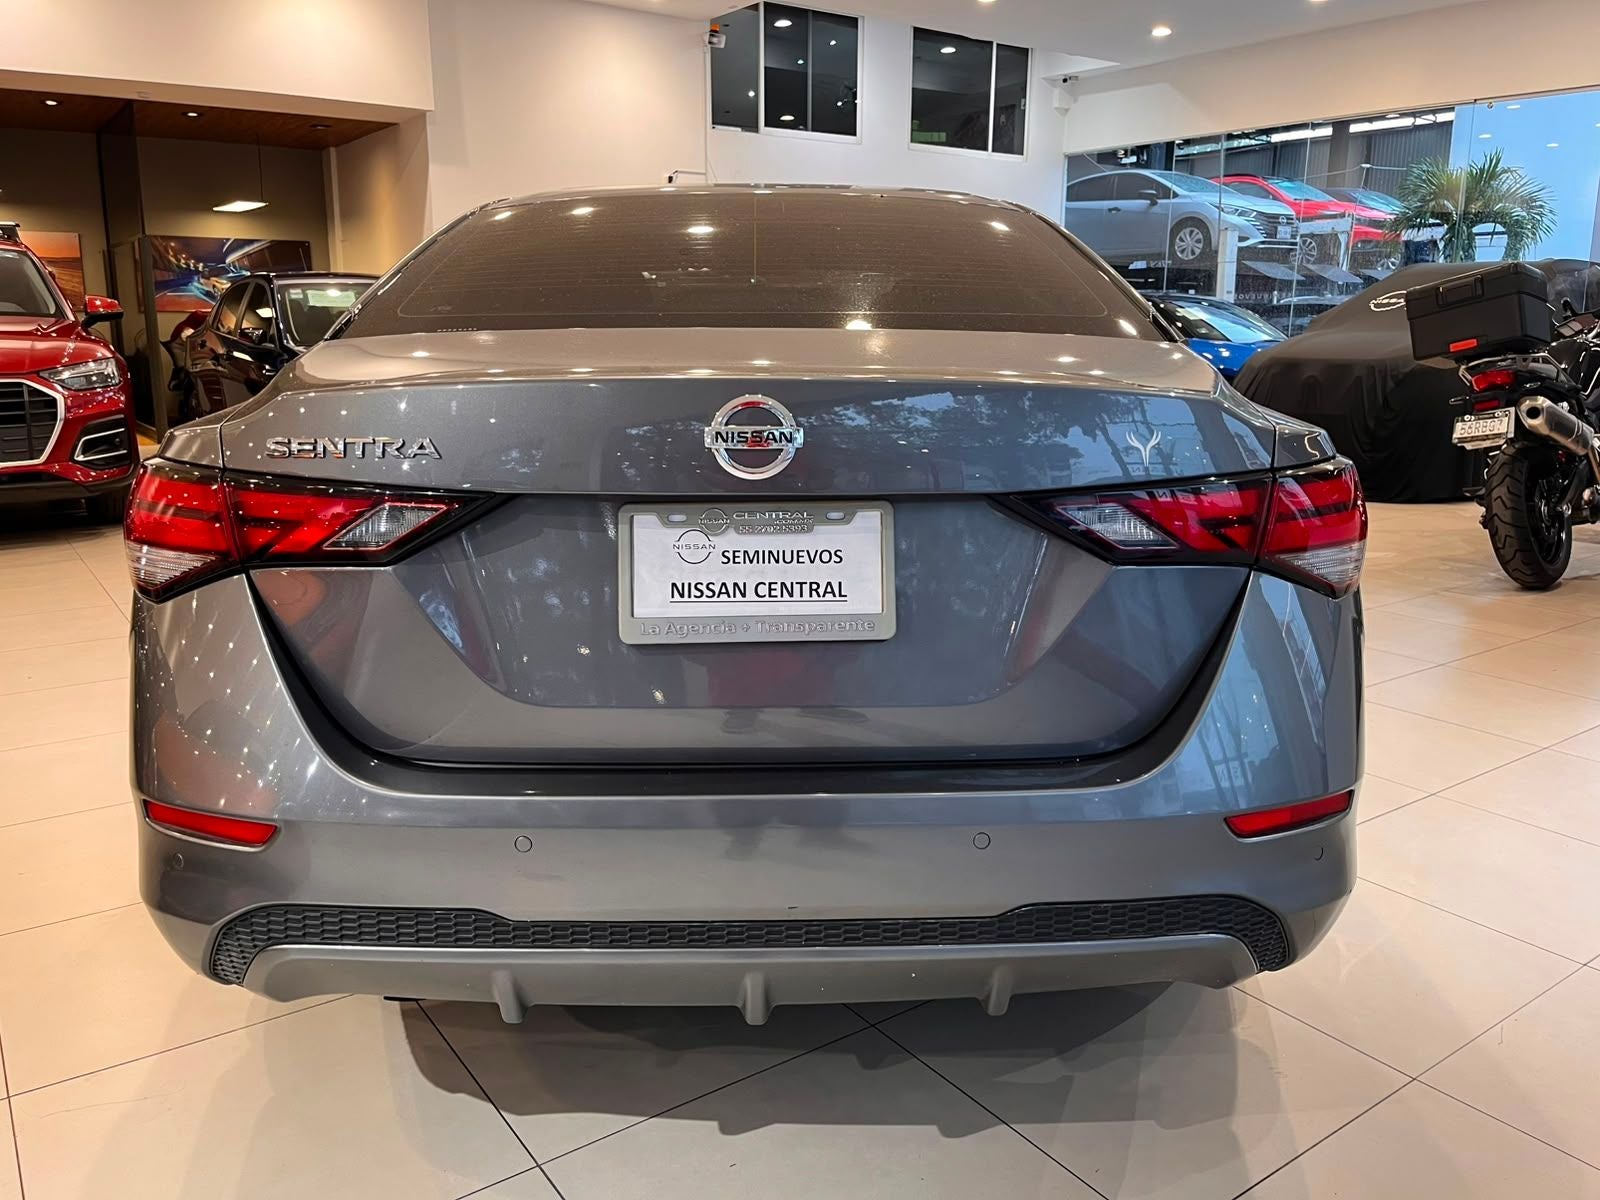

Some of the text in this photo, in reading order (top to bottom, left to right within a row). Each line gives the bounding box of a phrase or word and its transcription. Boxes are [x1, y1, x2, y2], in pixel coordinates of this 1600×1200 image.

[714, 430, 793, 444] NISSAN
[265, 436, 442, 459] SENTRA
[733, 511, 814, 519] CENTRAL
[721, 549, 843, 565] SEMINUEVOS
[670, 581, 848, 599] NISSAN CENTRAL
[640, 622, 660, 635] La
[664, 621, 737, 638] Agencia
[755, 619, 875, 636] Transparente
